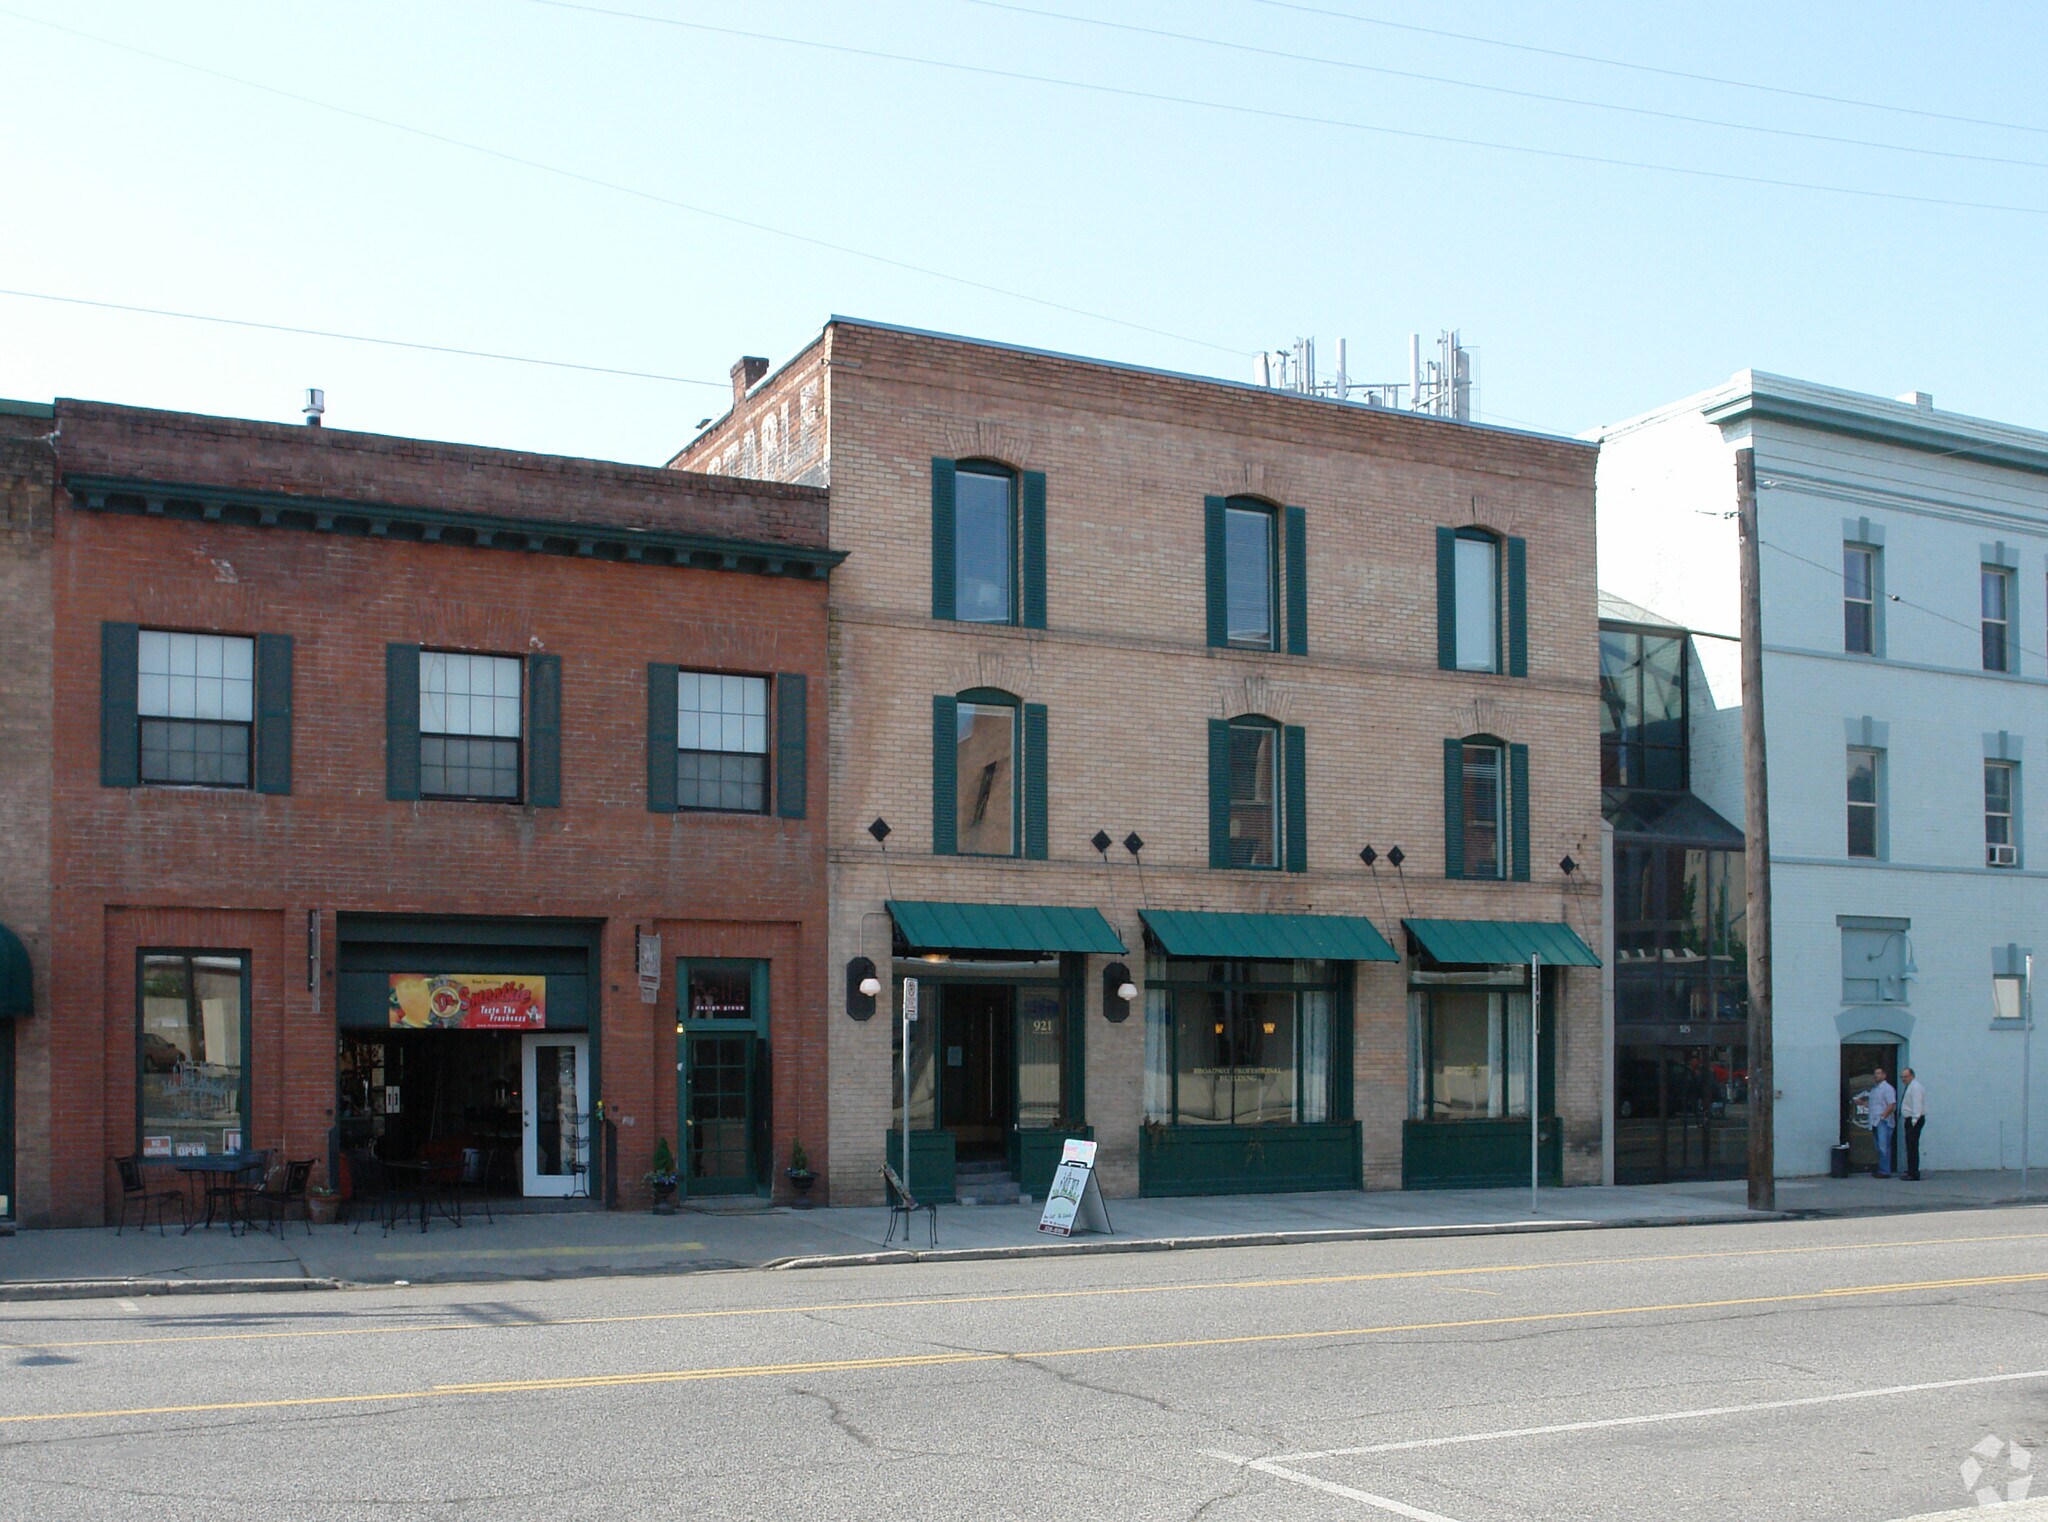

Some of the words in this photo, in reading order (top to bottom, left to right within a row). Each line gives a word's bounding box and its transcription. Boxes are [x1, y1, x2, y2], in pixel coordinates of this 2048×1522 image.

[459, 981, 532, 1011] Smoothie
[480, 1005, 500, 1014] Taste
[503, 1005, 516, 1014] The
[489, 1014, 526, 1022] Freshness
[1033, 1020, 1052, 1031] 921
[1193, 1067, 1230, 1075] BROADWAY
[177, 1146, 206, 1157] OPEN
